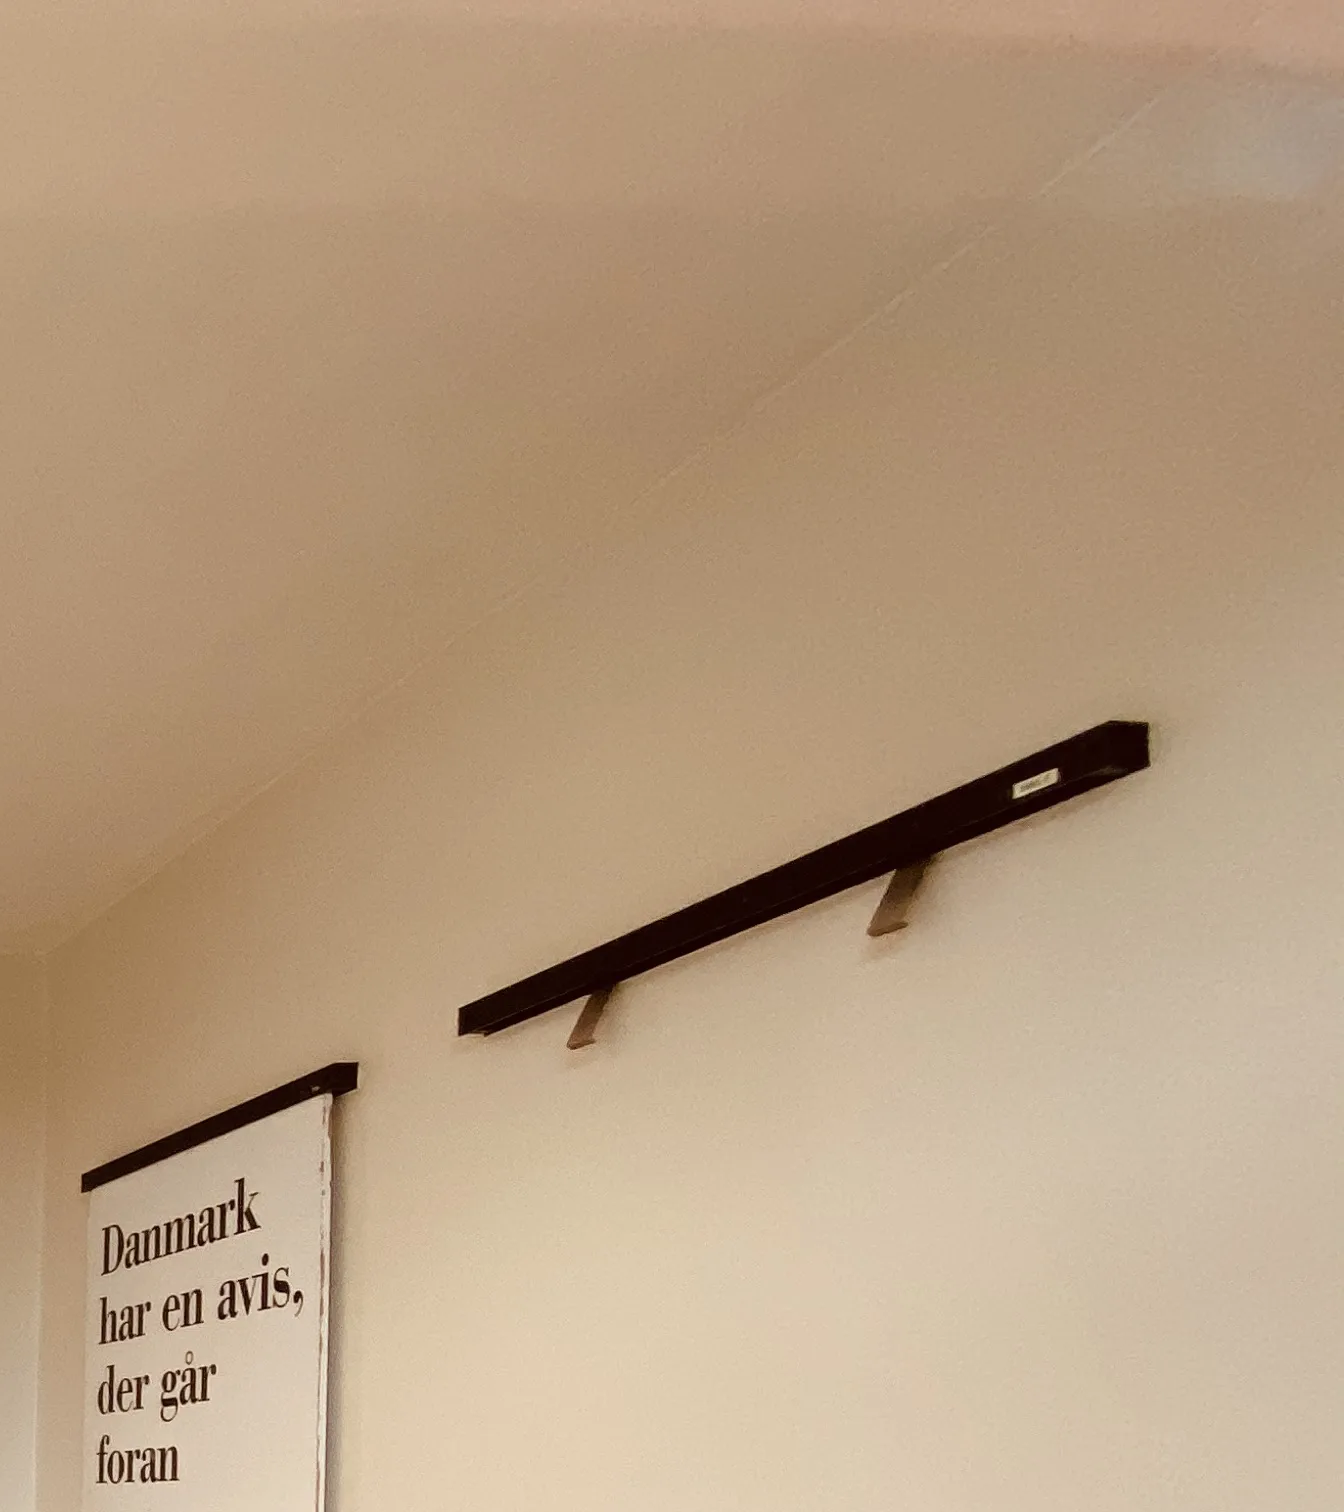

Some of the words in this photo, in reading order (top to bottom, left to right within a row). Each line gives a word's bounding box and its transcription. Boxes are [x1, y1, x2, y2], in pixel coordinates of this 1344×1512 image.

[100, 1177, 262, 1276] Danmark
[97, 1297, 152, 1345] har
[162, 1288, 204, 1332] en
[216, 1253, 304, 1320] avis,
[97, 1365, 150, 1415] der
[159, 1350, 217, 1423] går
[95, 1434, 180, 1484] foran
